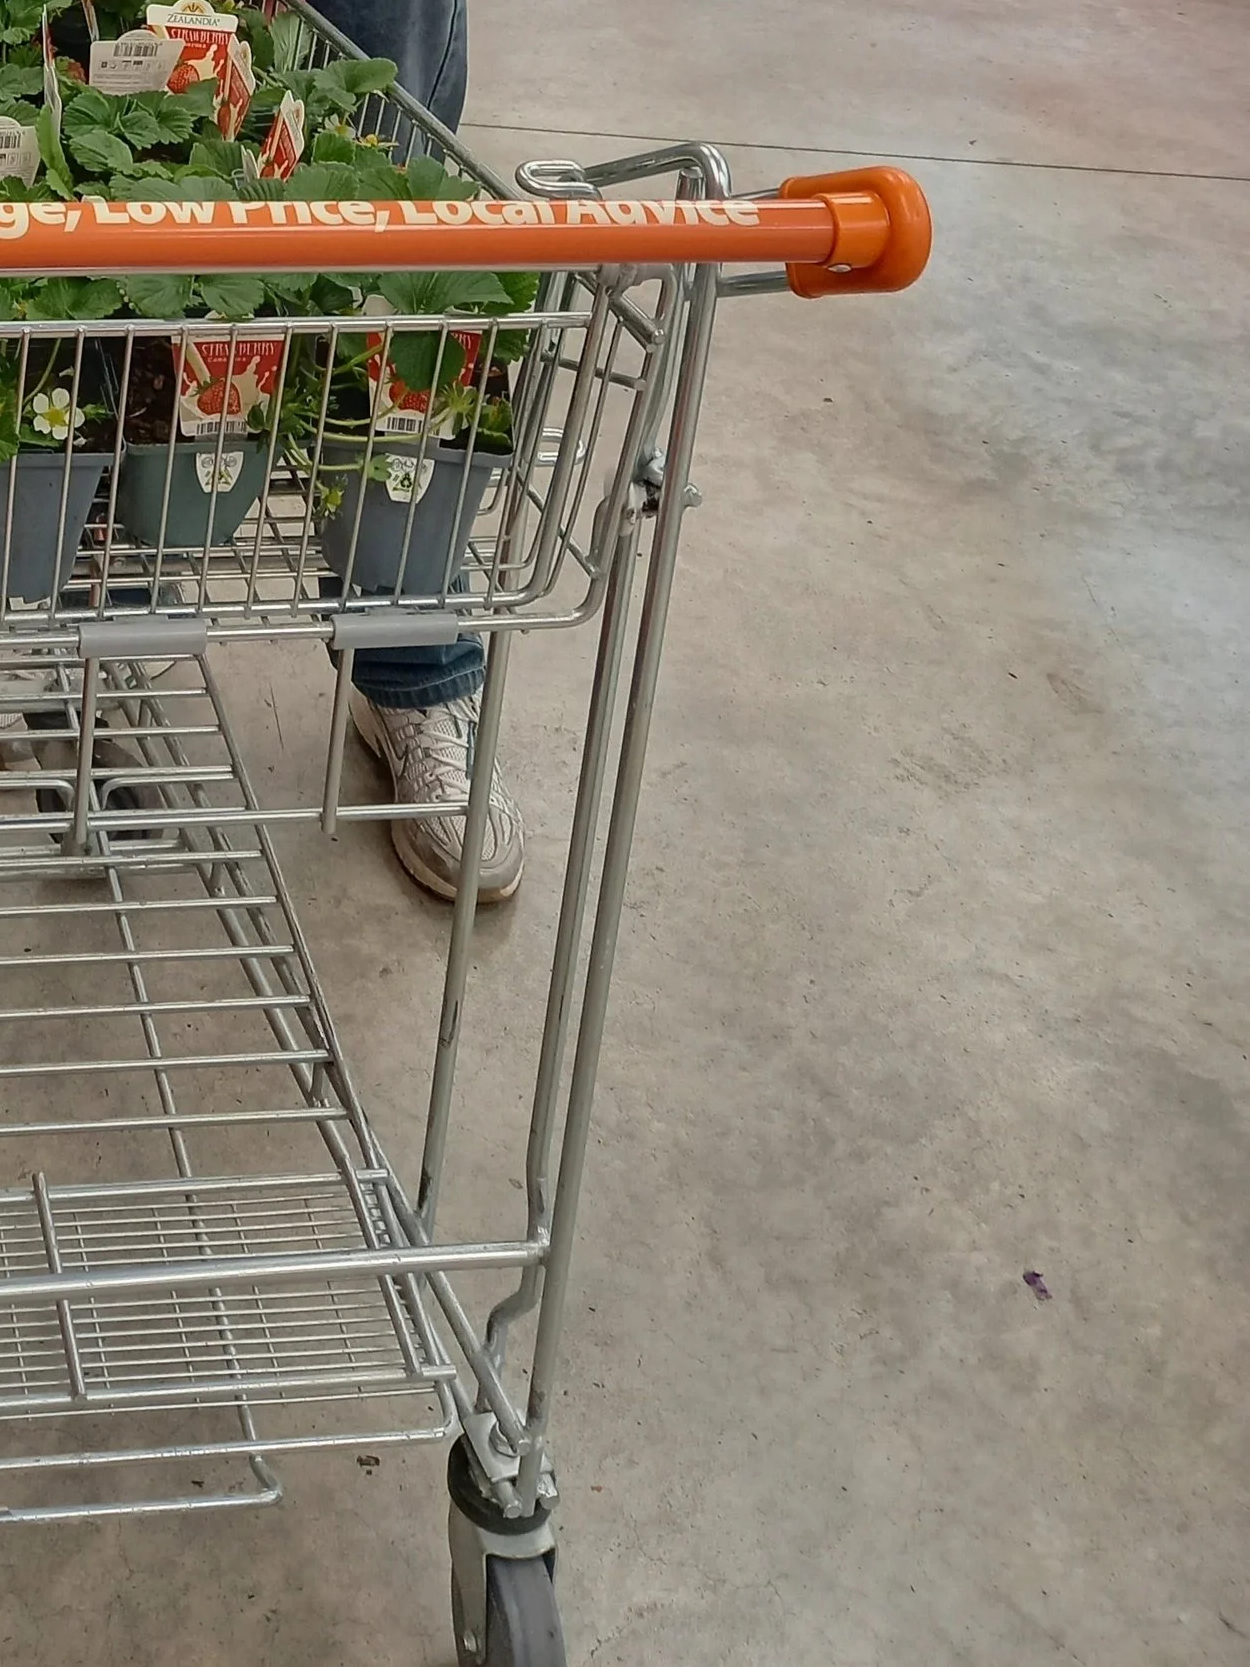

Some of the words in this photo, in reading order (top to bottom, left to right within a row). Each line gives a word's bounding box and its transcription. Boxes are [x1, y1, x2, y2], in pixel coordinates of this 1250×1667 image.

[93, 197, 215, 224] Low
[232, 199, 392, 233] Price,
[404, 199, 555, 225] Local
